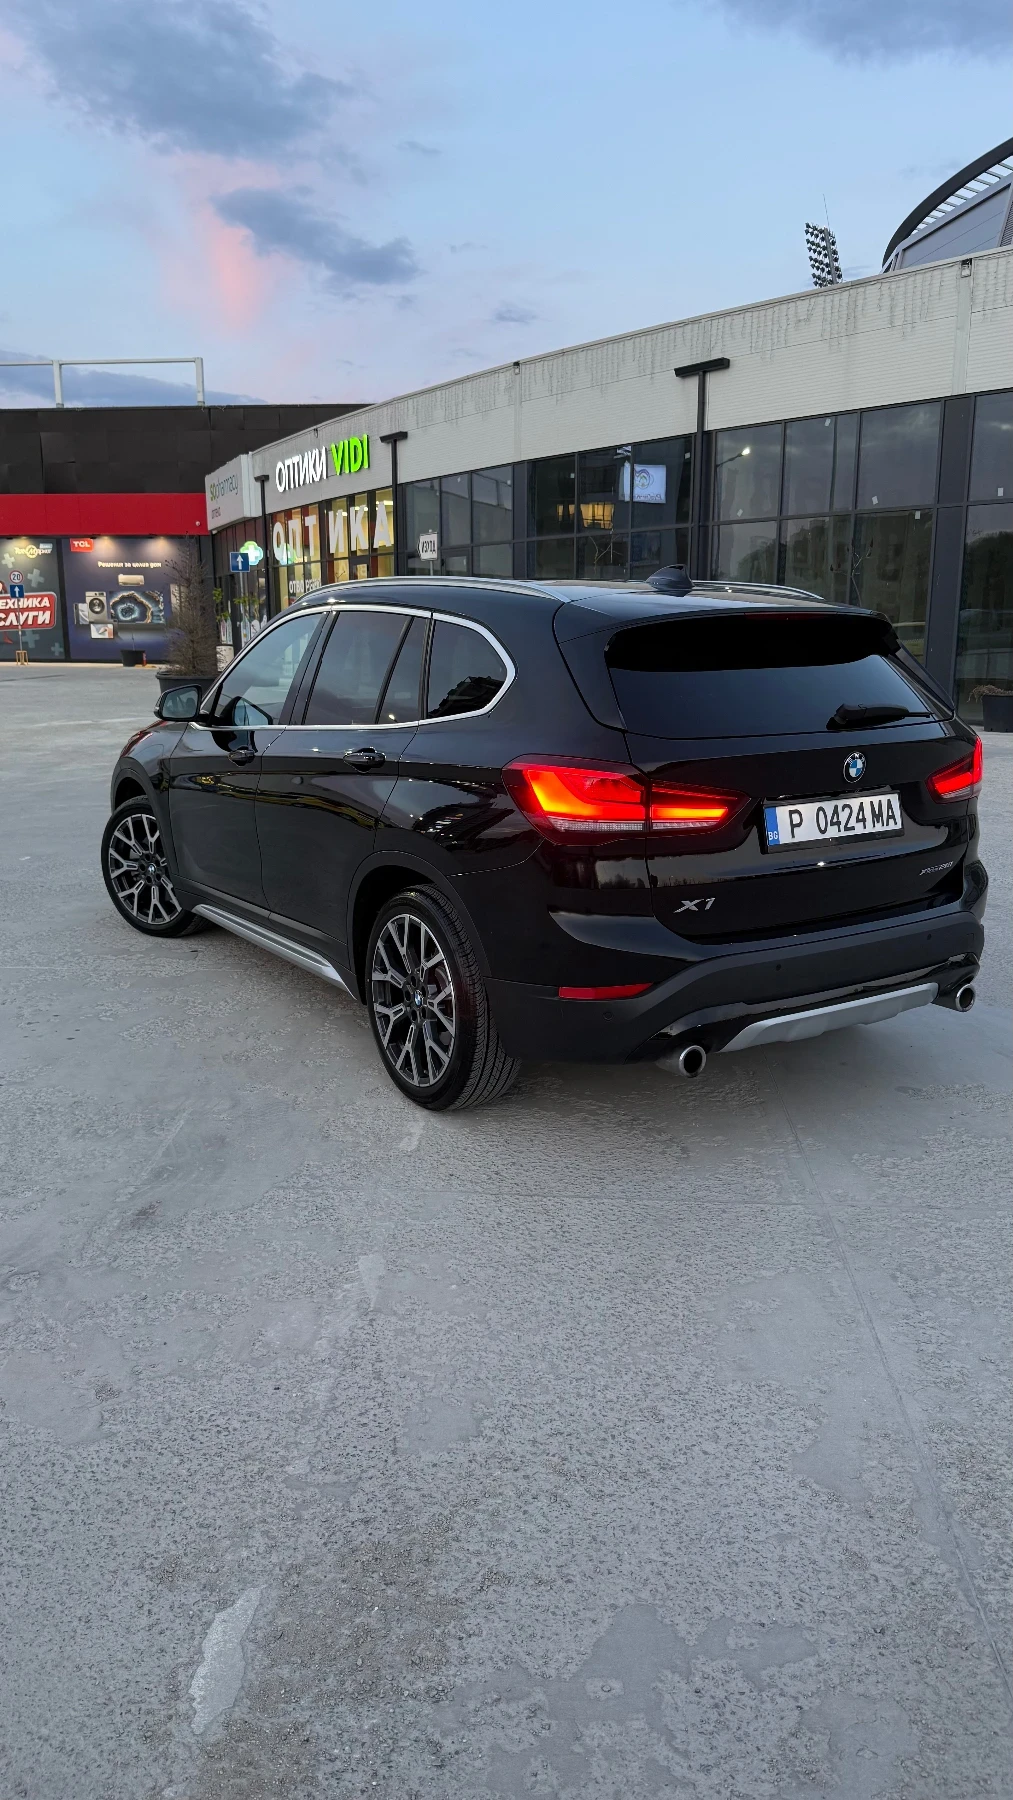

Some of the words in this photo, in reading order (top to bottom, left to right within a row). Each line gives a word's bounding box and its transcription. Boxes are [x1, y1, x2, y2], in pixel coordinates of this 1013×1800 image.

[276, 446, 327, 493] ОПТИКИ
[331, 434, 369, 475] VIDI
[273, 501, 392, 562] ОПТИКА
[12, 573, 21, 581] 20
[0, 597, 50, 610] ЕХНИКА
[0, 610, 51, 627] СЛУГИ
[788, 809, 803, 838] P
[768, 831, 778, 840] BG
[673, 897, 716, 914] X1
